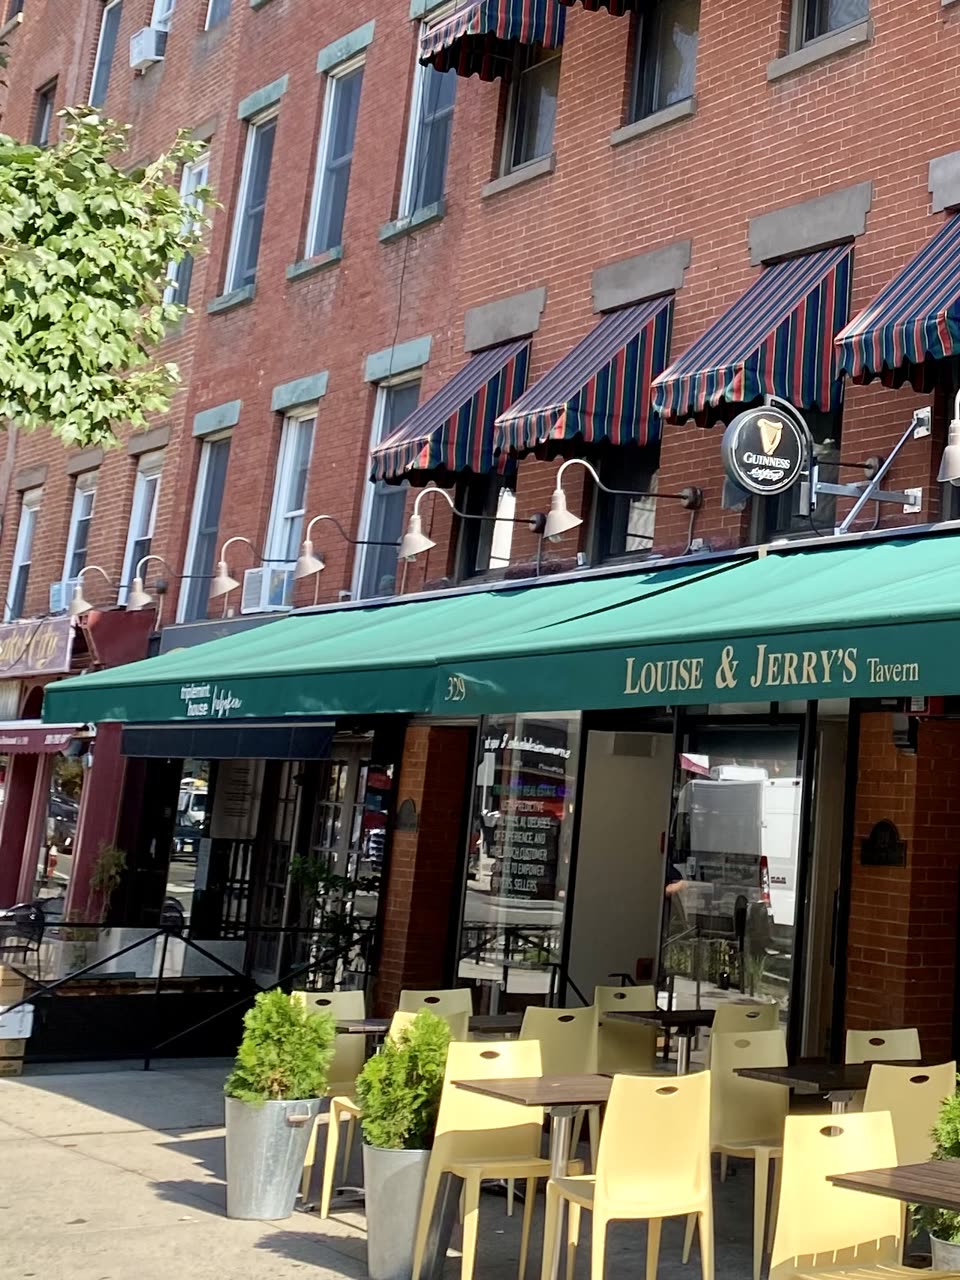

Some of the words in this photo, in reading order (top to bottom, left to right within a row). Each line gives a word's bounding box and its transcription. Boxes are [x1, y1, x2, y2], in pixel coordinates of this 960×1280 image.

[743, 451, 791, 469] GUINNESS
[623, 657, 704, 695] LOUISE
[715, 645, 740, 689] &
[750, 644, 858, 688] JERRY'S
[867, 657, 919, 683] Tavern
[444, 676, 466, 701] 329
